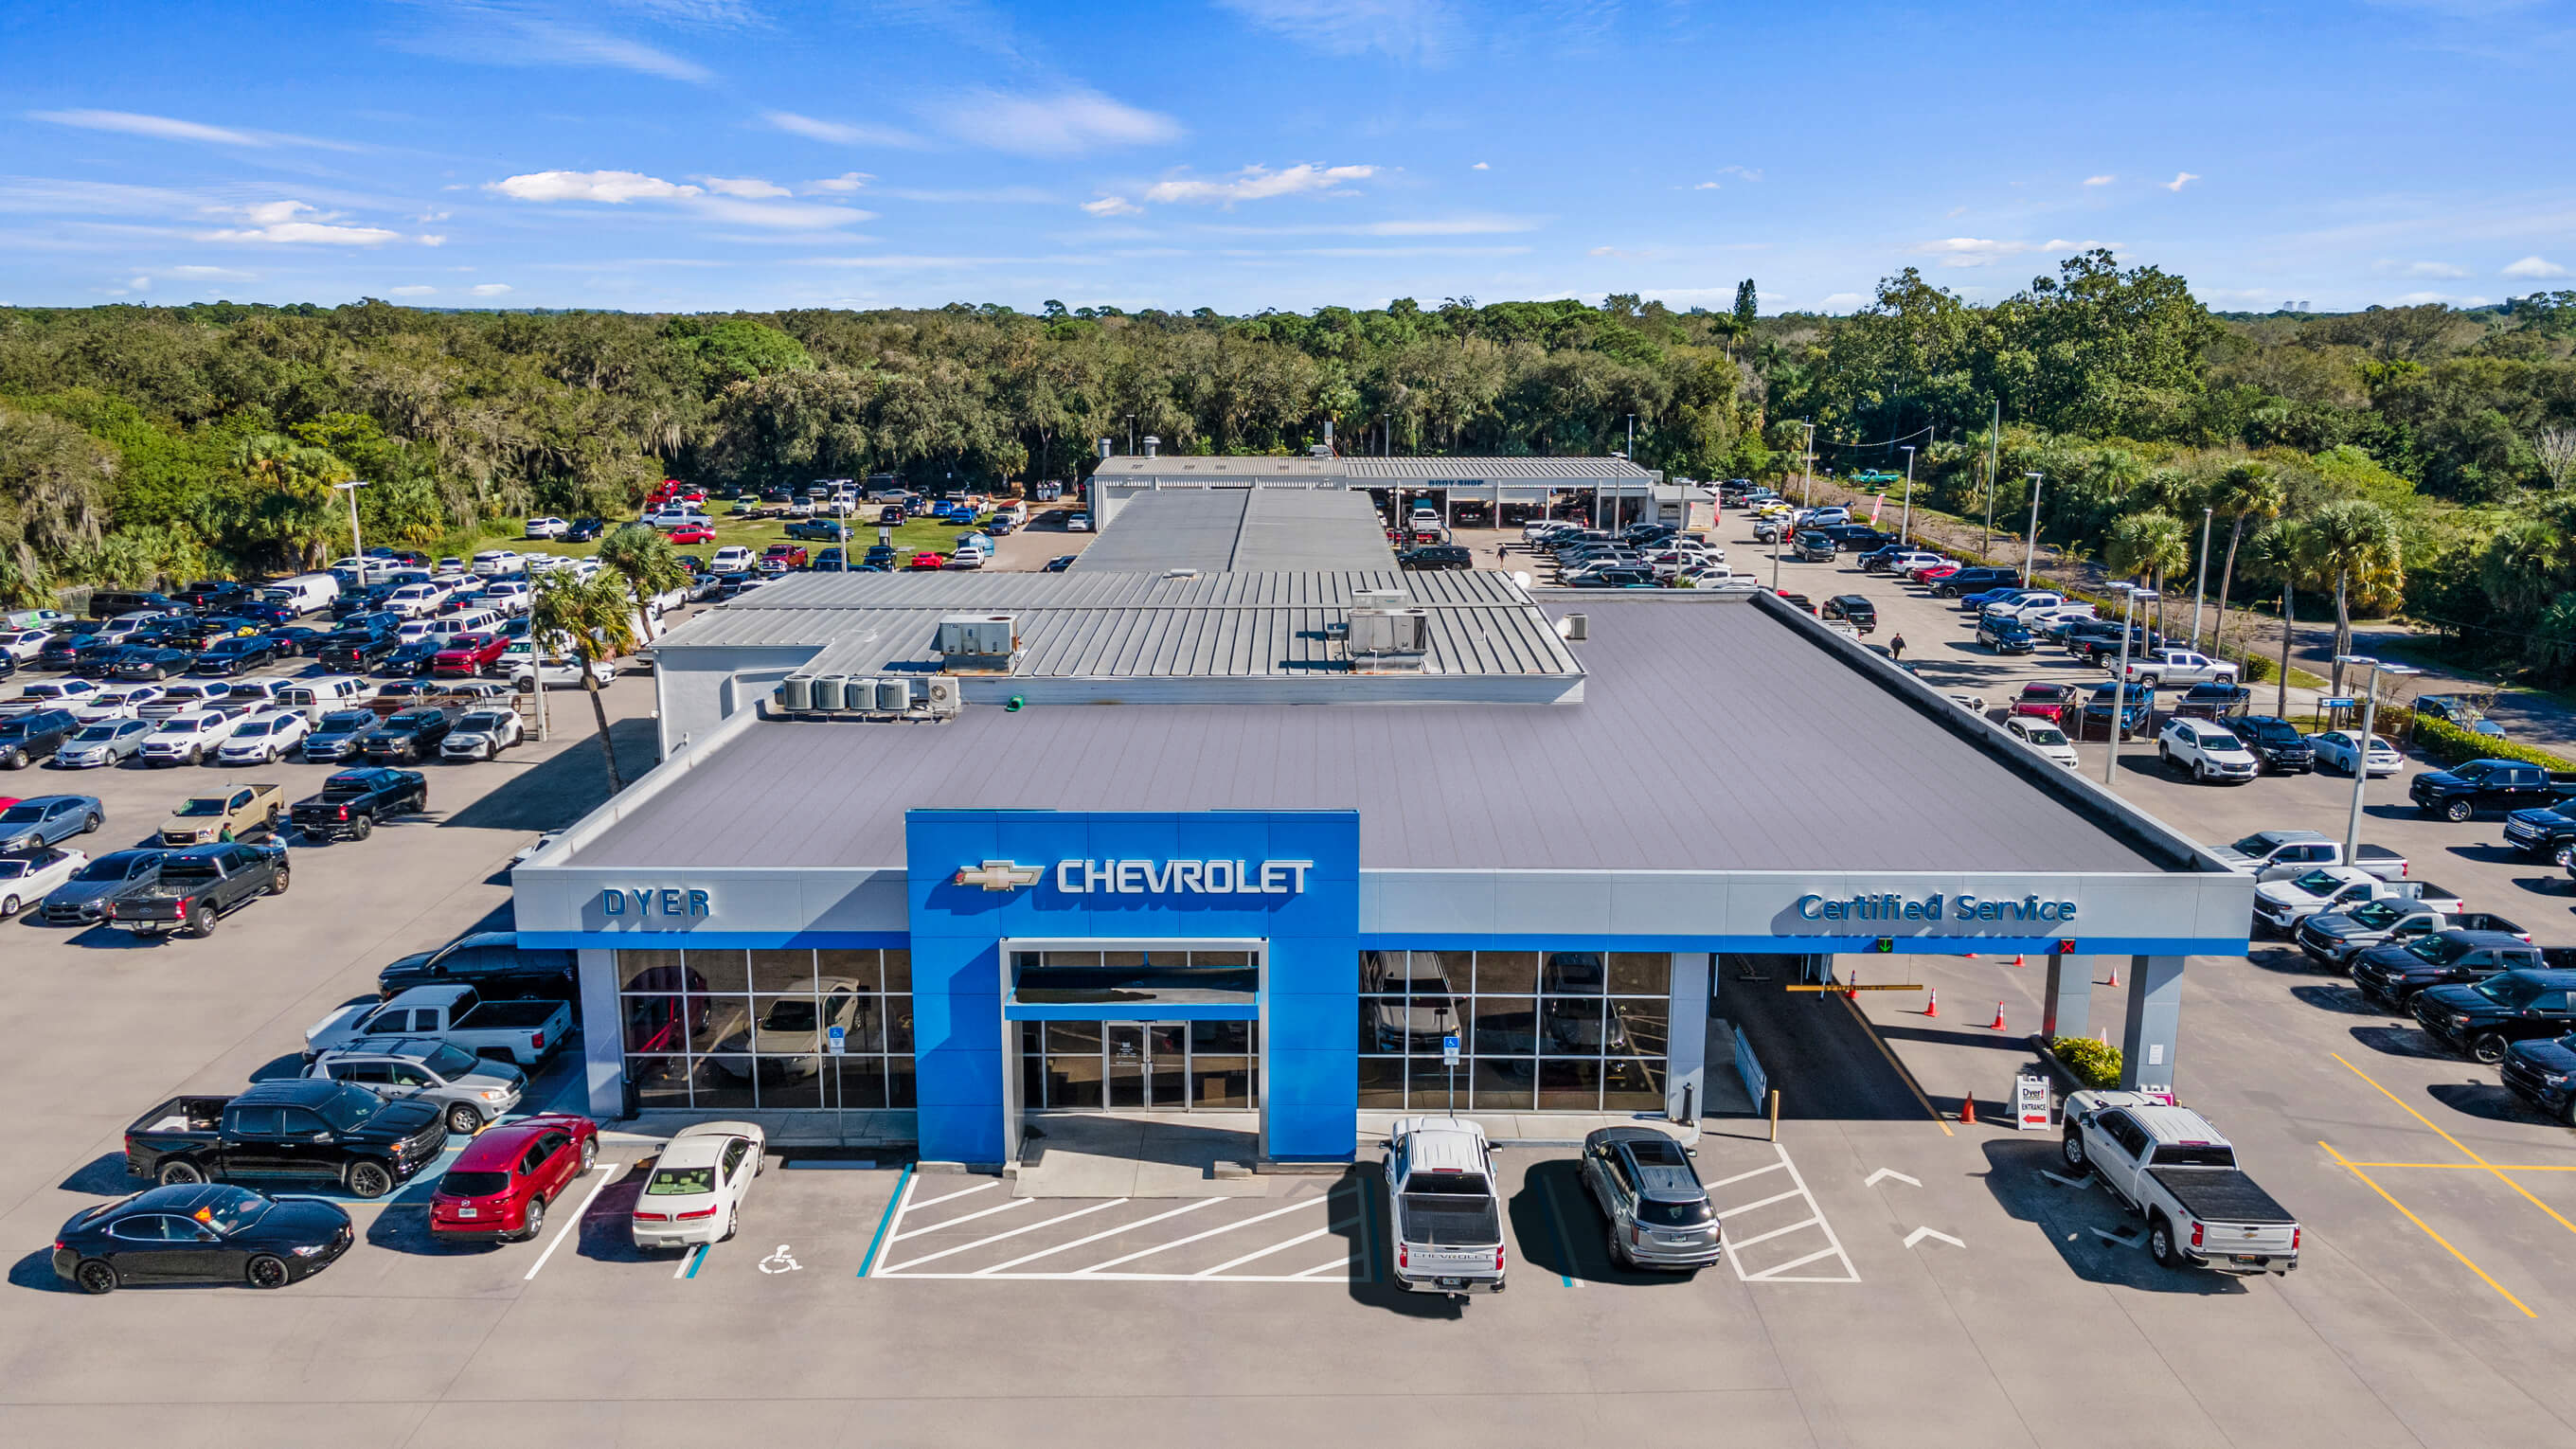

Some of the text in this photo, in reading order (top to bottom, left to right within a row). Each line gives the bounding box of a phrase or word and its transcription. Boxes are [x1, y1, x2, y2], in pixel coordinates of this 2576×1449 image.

[1057, 859, 1314, 894] CHEVROLET
[601, 887, 712, 917] DYER
[1798, 893, 2077, 921] Certified Service
[2021, 1102, 2047, 1111] ENTRANCE
[1413, 1252, 1493, 1261] CHEVROLET
